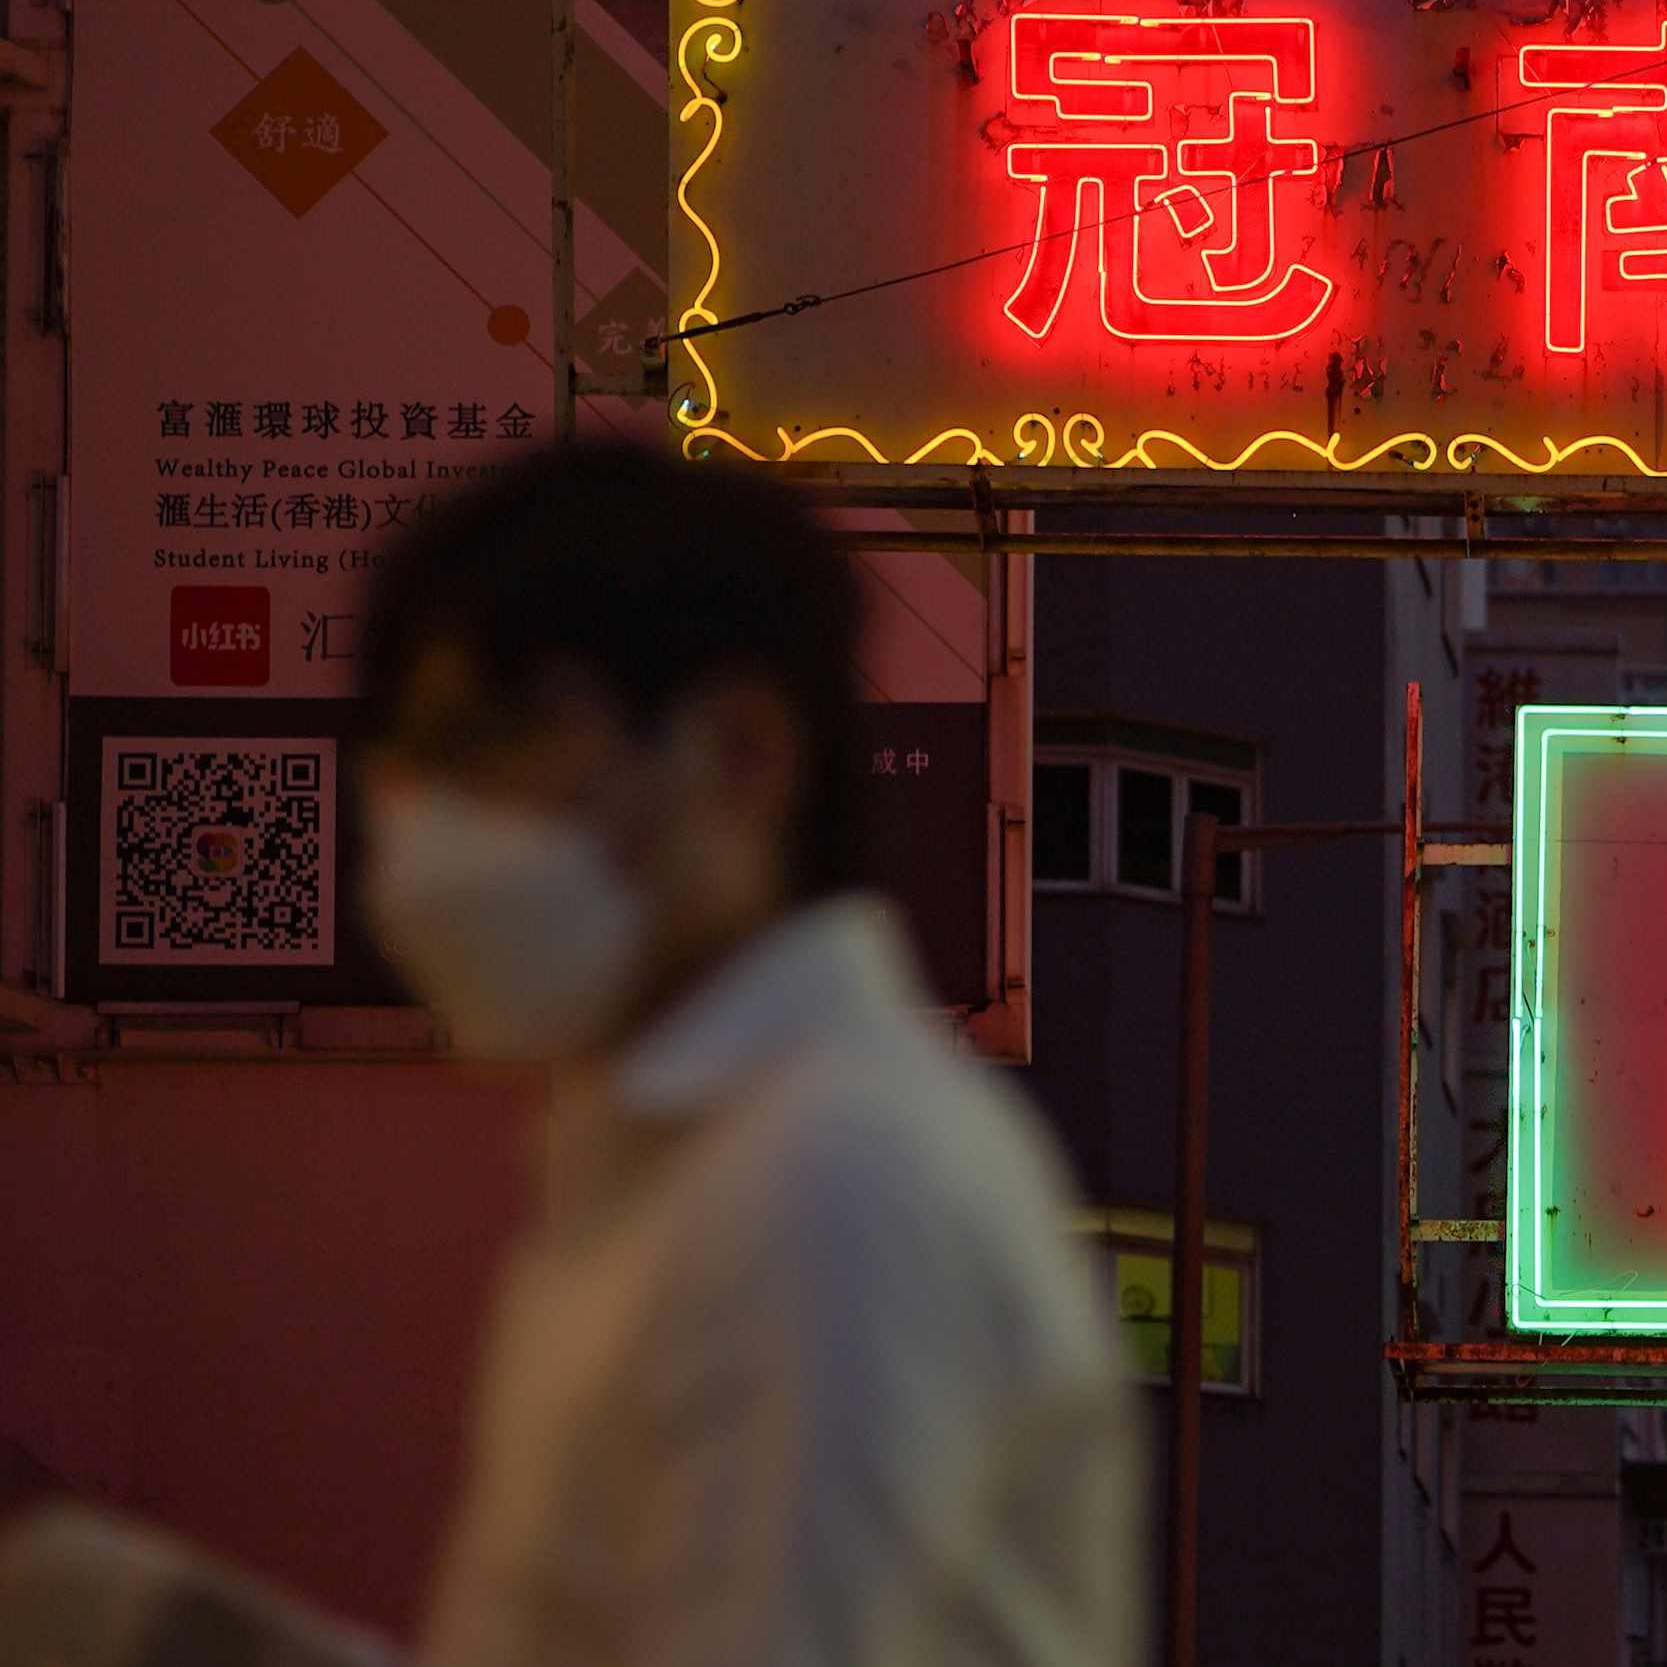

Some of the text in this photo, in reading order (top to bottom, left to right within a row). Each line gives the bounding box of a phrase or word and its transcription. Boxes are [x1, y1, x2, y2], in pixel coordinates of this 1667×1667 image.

[155, 458, 252, 483] Wealthy
[263, 459, 329, 480] Peace
[337, 458, 417, 480] Global
[153, 548, 246, 569] Student
[256, 548, 329, 574] Living
[180, 620, 262, 653] 小红书
